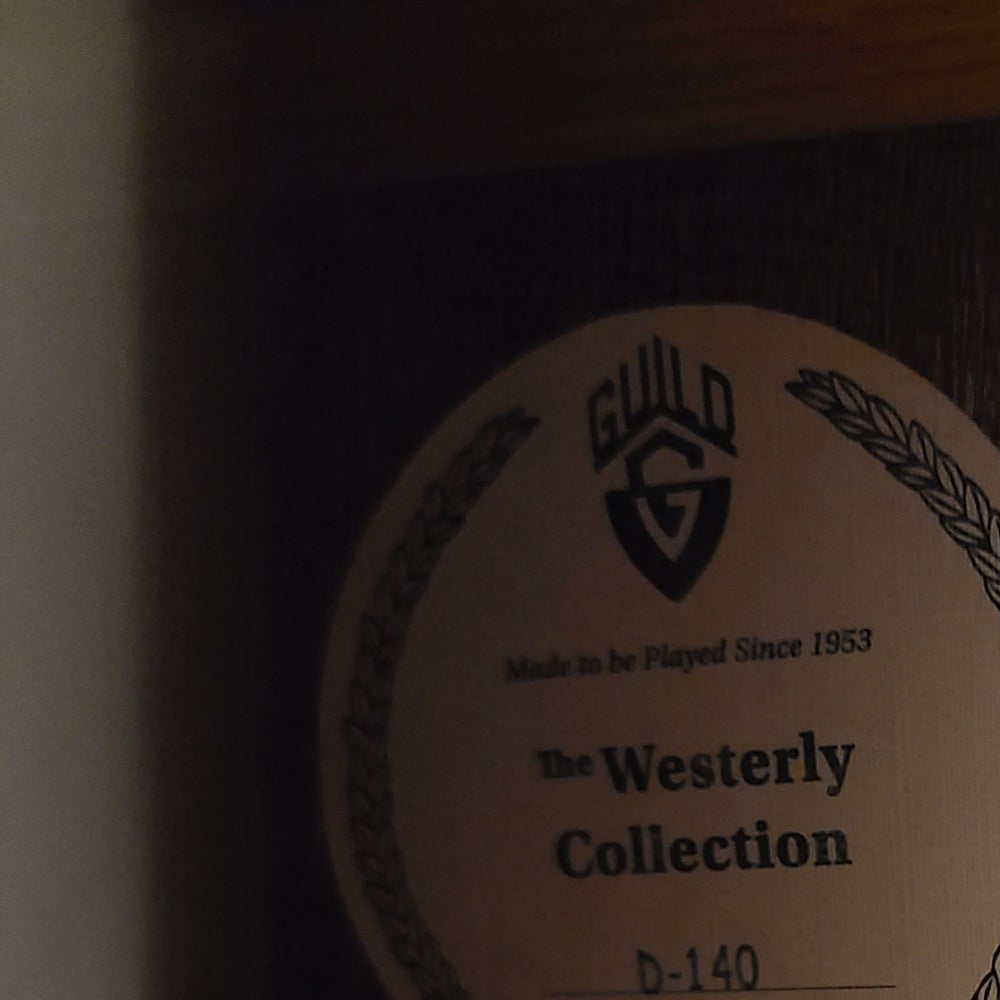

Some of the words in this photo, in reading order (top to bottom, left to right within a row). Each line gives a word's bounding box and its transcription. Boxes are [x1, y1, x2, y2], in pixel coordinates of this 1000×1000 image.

[587, 335, 738, 473] GUILD
[506, 655, 573, 683] Made
[577, 656, 602, 677] to
[608, 649, 637, 674] be
[643, 638, 727, 674] Played
[734, 636, 802, 662] Since
[811, 628, 873, 657] 1953
[536, 749, 595, 780] The
[600, 730, 856, 797] Westerly
[555, 819, 853, 879] Collection
[637, 943, 760, 995] D-140
